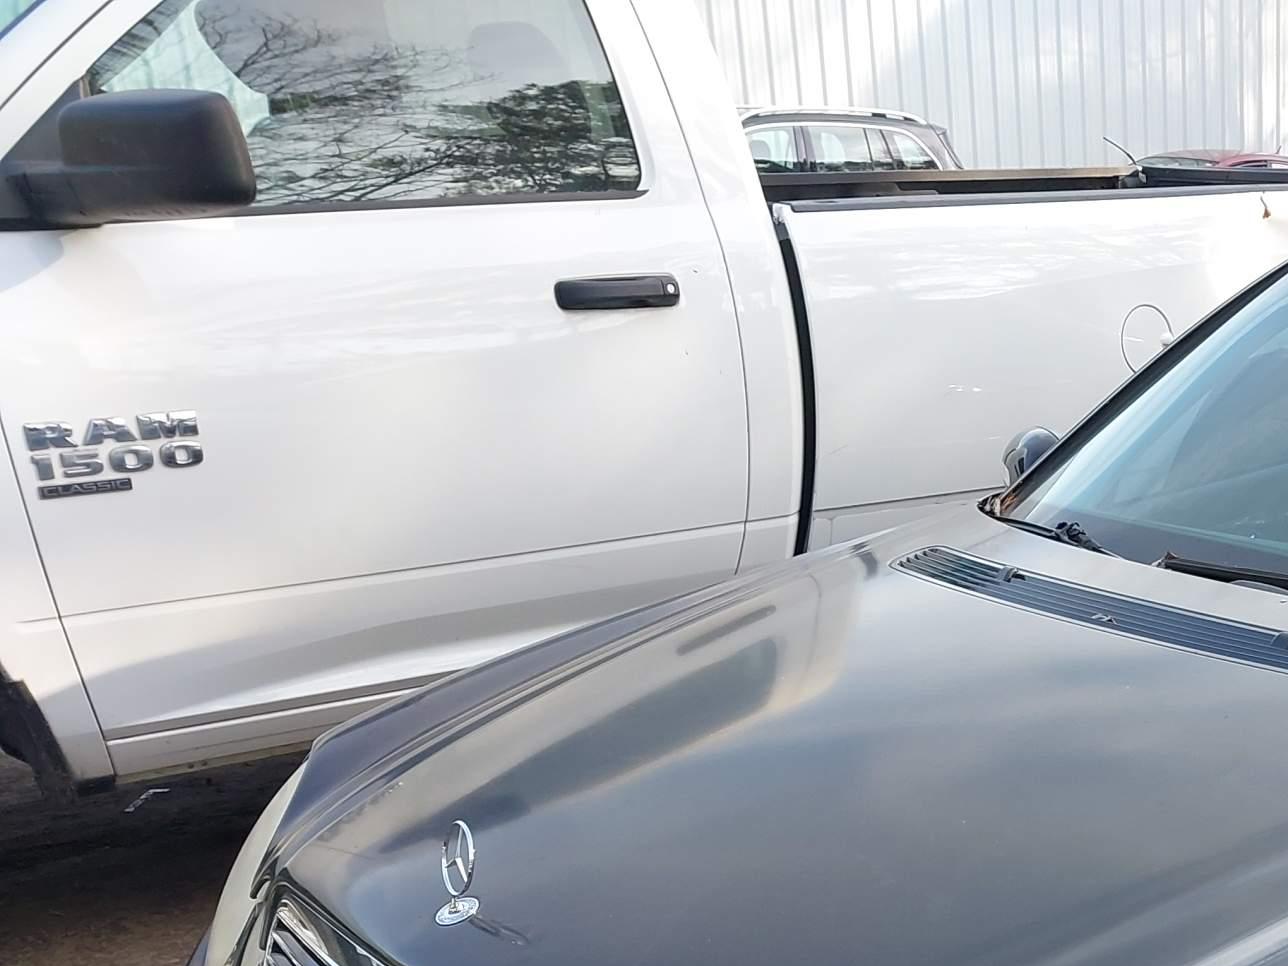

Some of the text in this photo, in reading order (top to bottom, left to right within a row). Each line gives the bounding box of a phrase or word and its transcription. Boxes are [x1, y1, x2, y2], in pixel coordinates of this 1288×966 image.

[23, 409, 199, 452] RAM
[30, 440, 204, 481] 1500
[43, 478, 132, 498] CLASSIC
